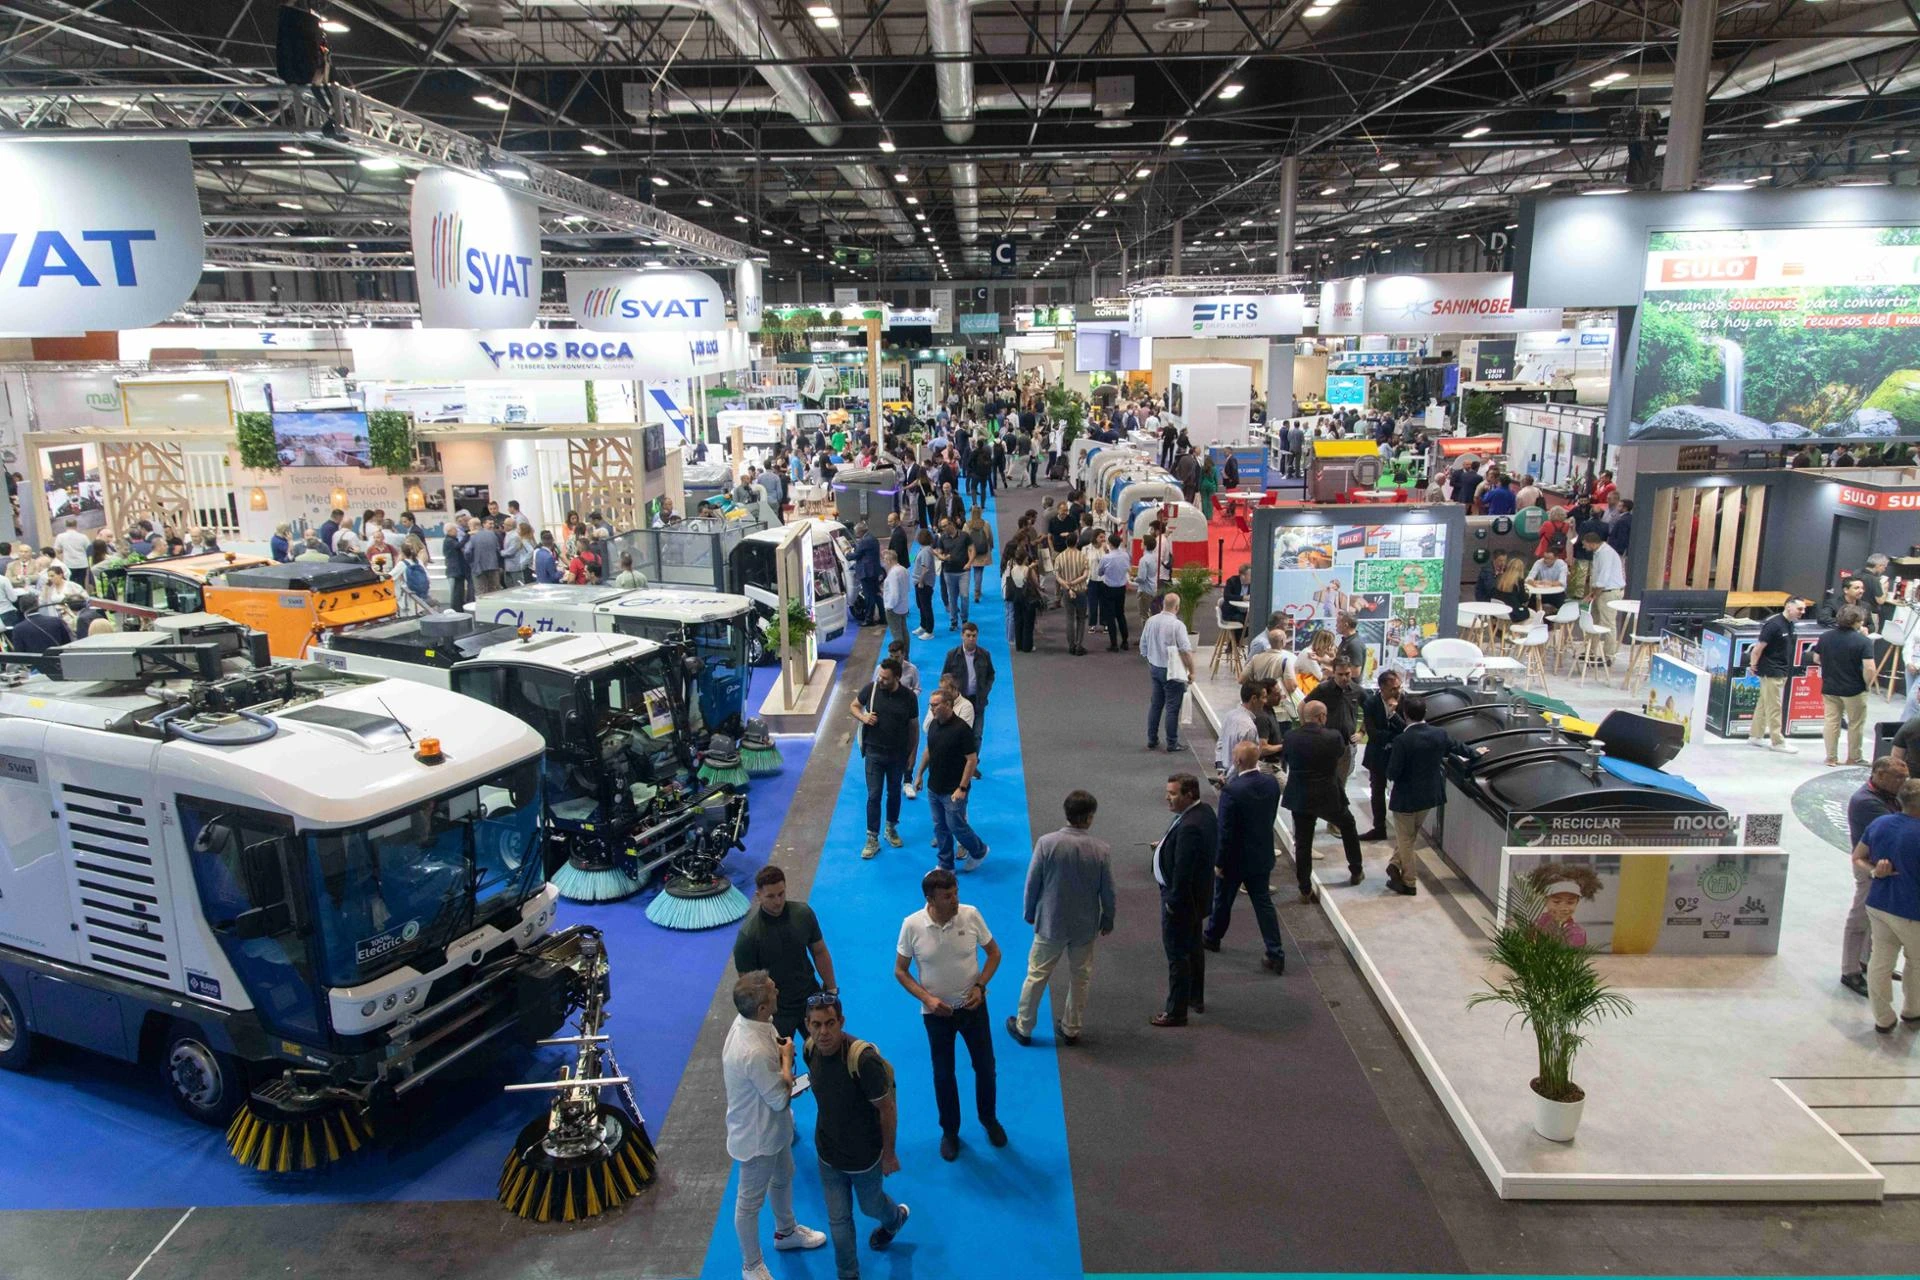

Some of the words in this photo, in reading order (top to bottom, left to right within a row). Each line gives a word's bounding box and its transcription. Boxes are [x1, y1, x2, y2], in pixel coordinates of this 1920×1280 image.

[1491, 232, 1509, 253] D
[996, 243, 1011, 264] C
[466, 247, 533, 298] SVAT
[1671, 258, 1744, 279] SULO
[620, 298, 709, 319] SVAT
[1220, 303, 1258, 320] FFS
[1658, 299, 1723, 313] Creamos
[1727, 297, 1798, 312] soluciones
[1804, 299, 1839, 315] para
[1843, 296, 1912, 309] convertir
[1700, 317, 1717, 329] de
[1723, 317, 1750, 331] hoy
[1755, 319, 1773, 328] en
[1778, 316, 1797, 327] los
[1803, 315, 1862, 329] recursos
[1867, 313, 1890, 326] del
[508, 342, 559, 360] ROS
[564, 342, 635, 360] ROCA
[512, 464, 529, 480] SVAT
[346, 484, 388, 496] ervicio
[1843, 489, 1876, 506] SULO
[7, 762, 33, 775] SVAT
[1552, 817, 1621, 830] RECICLAR
[1551, 834, 1612, 846] REDUCIR
[357, 935, 401, 961] Electric
[371, 934, 392, 948] 100%
